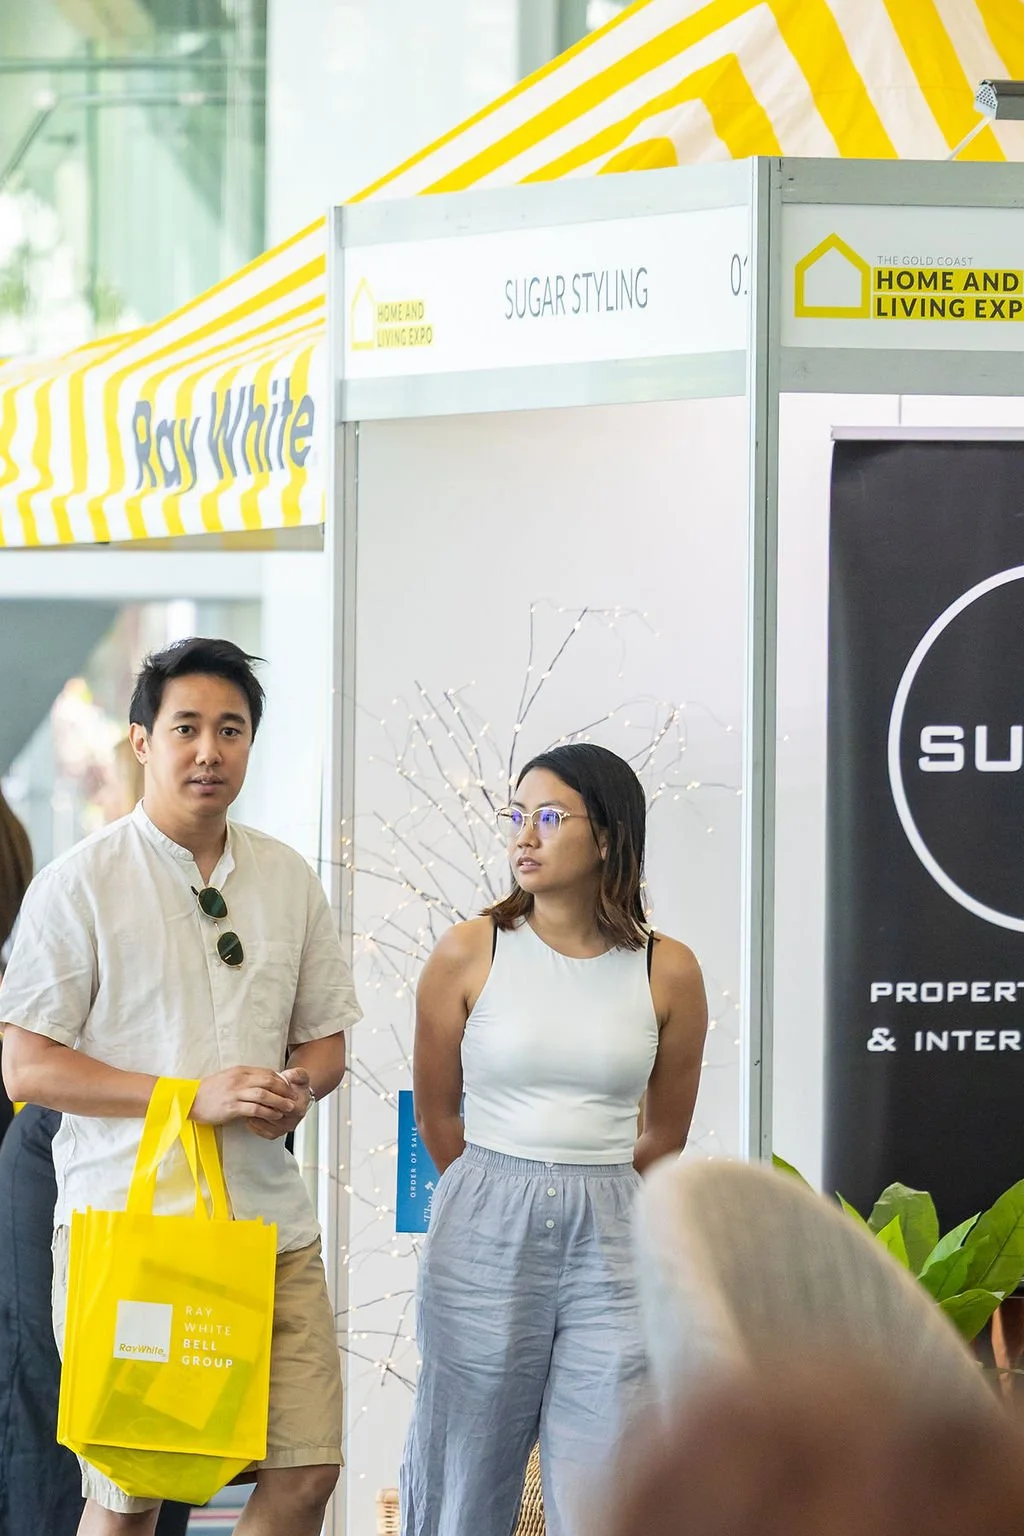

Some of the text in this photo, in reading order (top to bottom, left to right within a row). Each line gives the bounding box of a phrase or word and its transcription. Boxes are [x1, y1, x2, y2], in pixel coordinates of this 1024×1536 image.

[877, 255, 973, 267] THE GOLD COAST
[877, 270, 1019, 292] HOME AND
[505, 267, 648, 320] SUGAR STYLING
[377, 301, 425, 322] HOME AND
[877, 297, 1024, 319] LIVING EXP
[377, 326, 433, 348] LIVING EXPO
[132, 377, 315, 496] Ray White
[866, 1027, 1022, 1052] & INTER
[410, 1152, 417, 1164] OF
[185, 1306, 213, 1318] RAY
[184, 1322, 232, 1336] WHITE
[183, 1338, 217, 1351] BELL
[181, 1355, 233, 1369] GROUP
